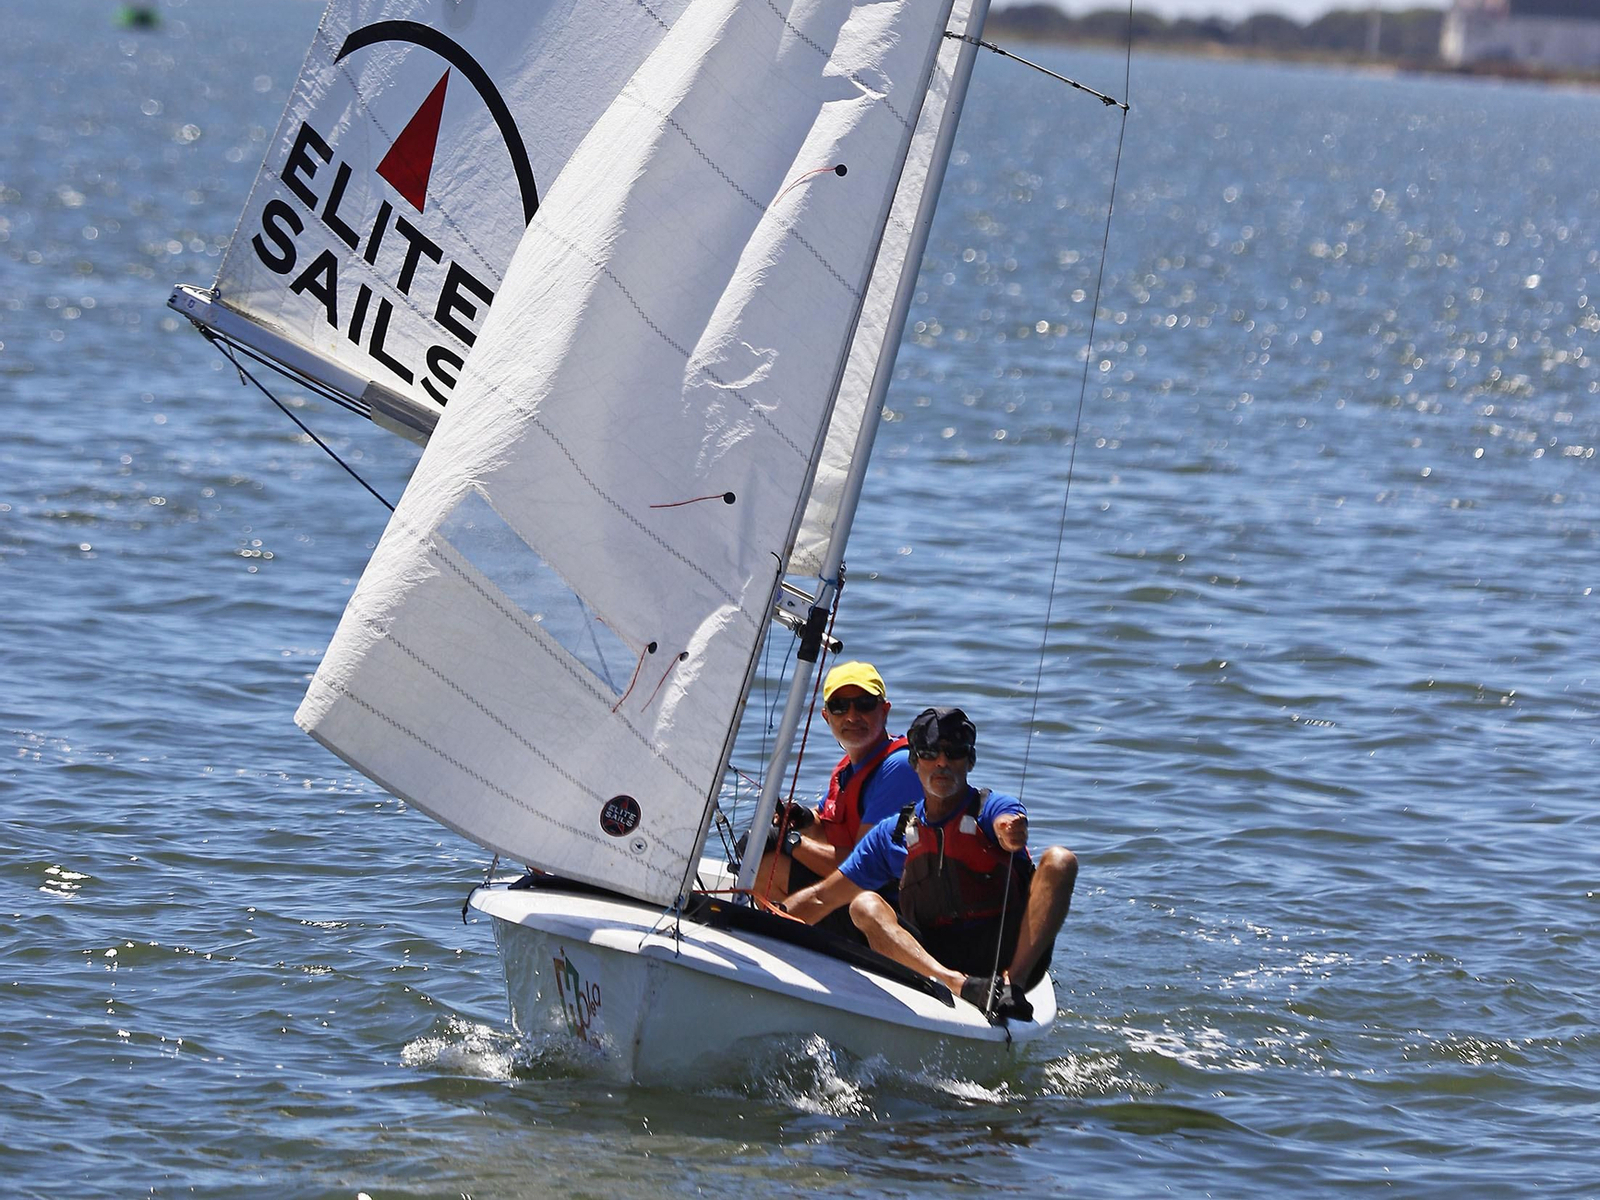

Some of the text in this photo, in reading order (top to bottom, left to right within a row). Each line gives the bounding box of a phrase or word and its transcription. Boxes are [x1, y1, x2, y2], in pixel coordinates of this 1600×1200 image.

[281, 120, 495, 348] ELITE
[605, 810, 633, 828] SAILS
[608, 804, 636, 821] ELITE
